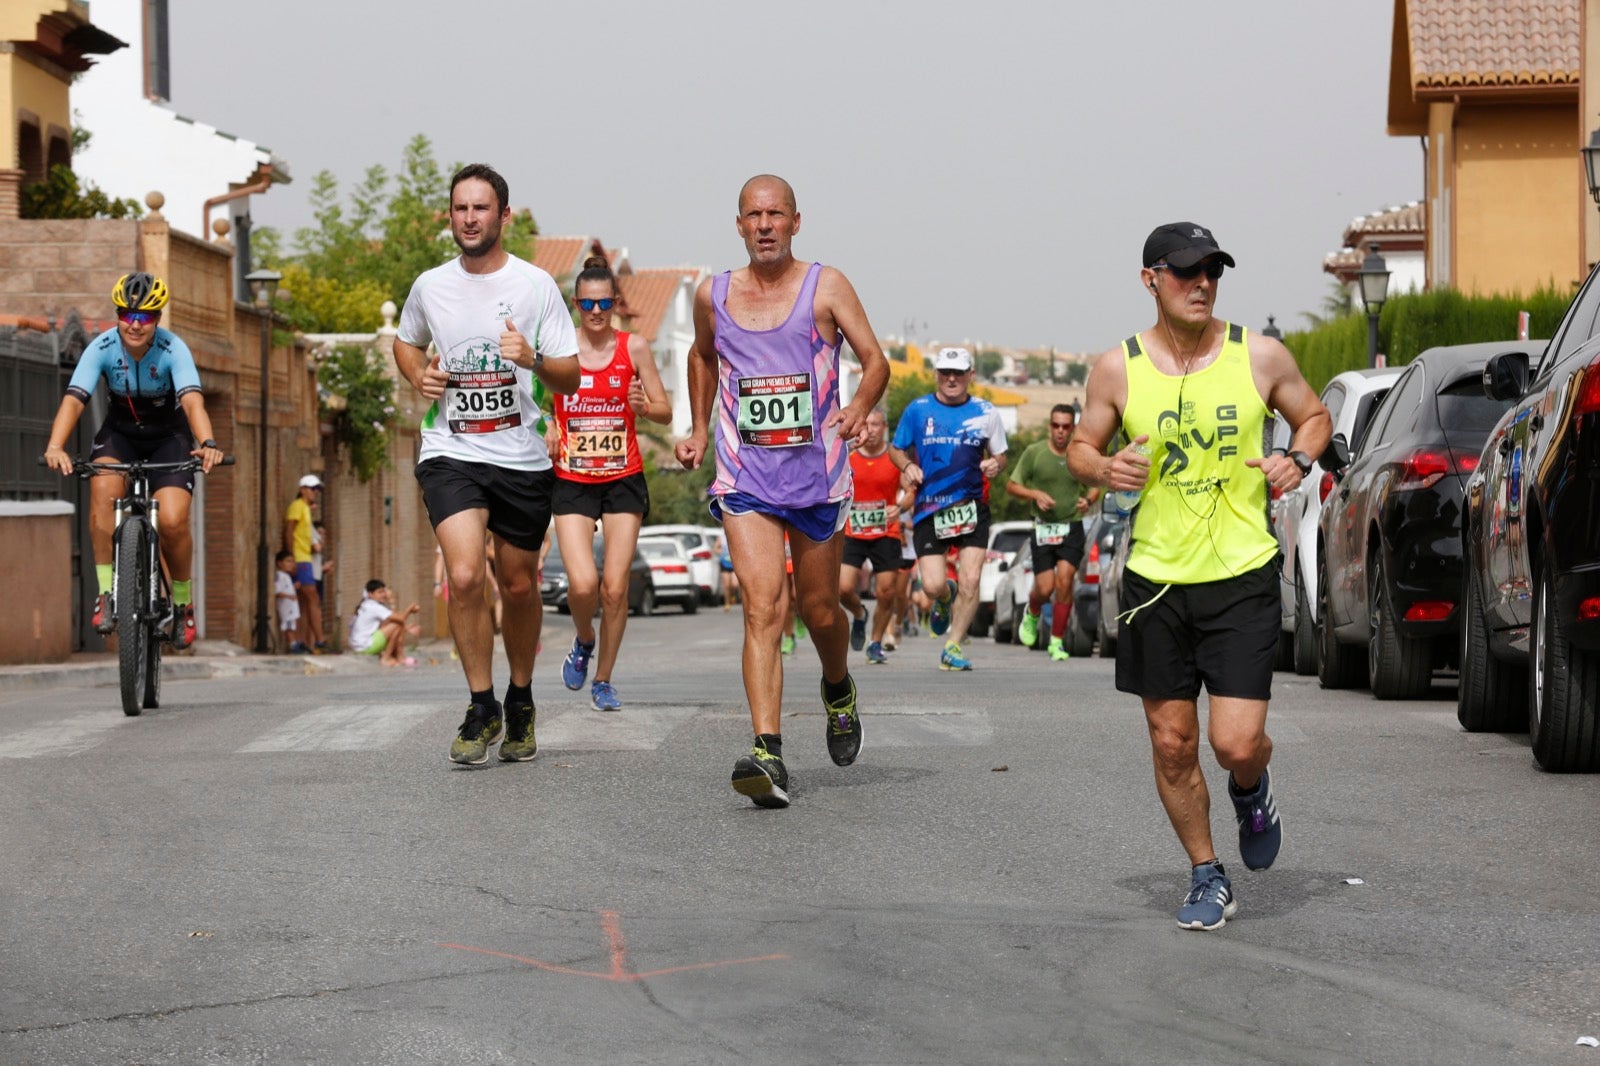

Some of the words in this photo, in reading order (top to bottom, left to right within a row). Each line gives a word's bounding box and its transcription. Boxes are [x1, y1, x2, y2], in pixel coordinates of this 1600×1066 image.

[460, 374, 472, 382] GRAN
[473, 372, 490, 381] PREMIO
[752, 379, 766, 387] GRAN
[766, 377, 784, 387] PREMIO
[785, 377, 791, 385] DE
[792, 375, 806, 384] FONDO
[456, 389, 514, 412] 3058
[563, 393, 625, 412] Polisalud
[750, 397, 799, 425] 901
[577, 436, 622, 451] 2140
[852, 511, 884, 524] 1147
